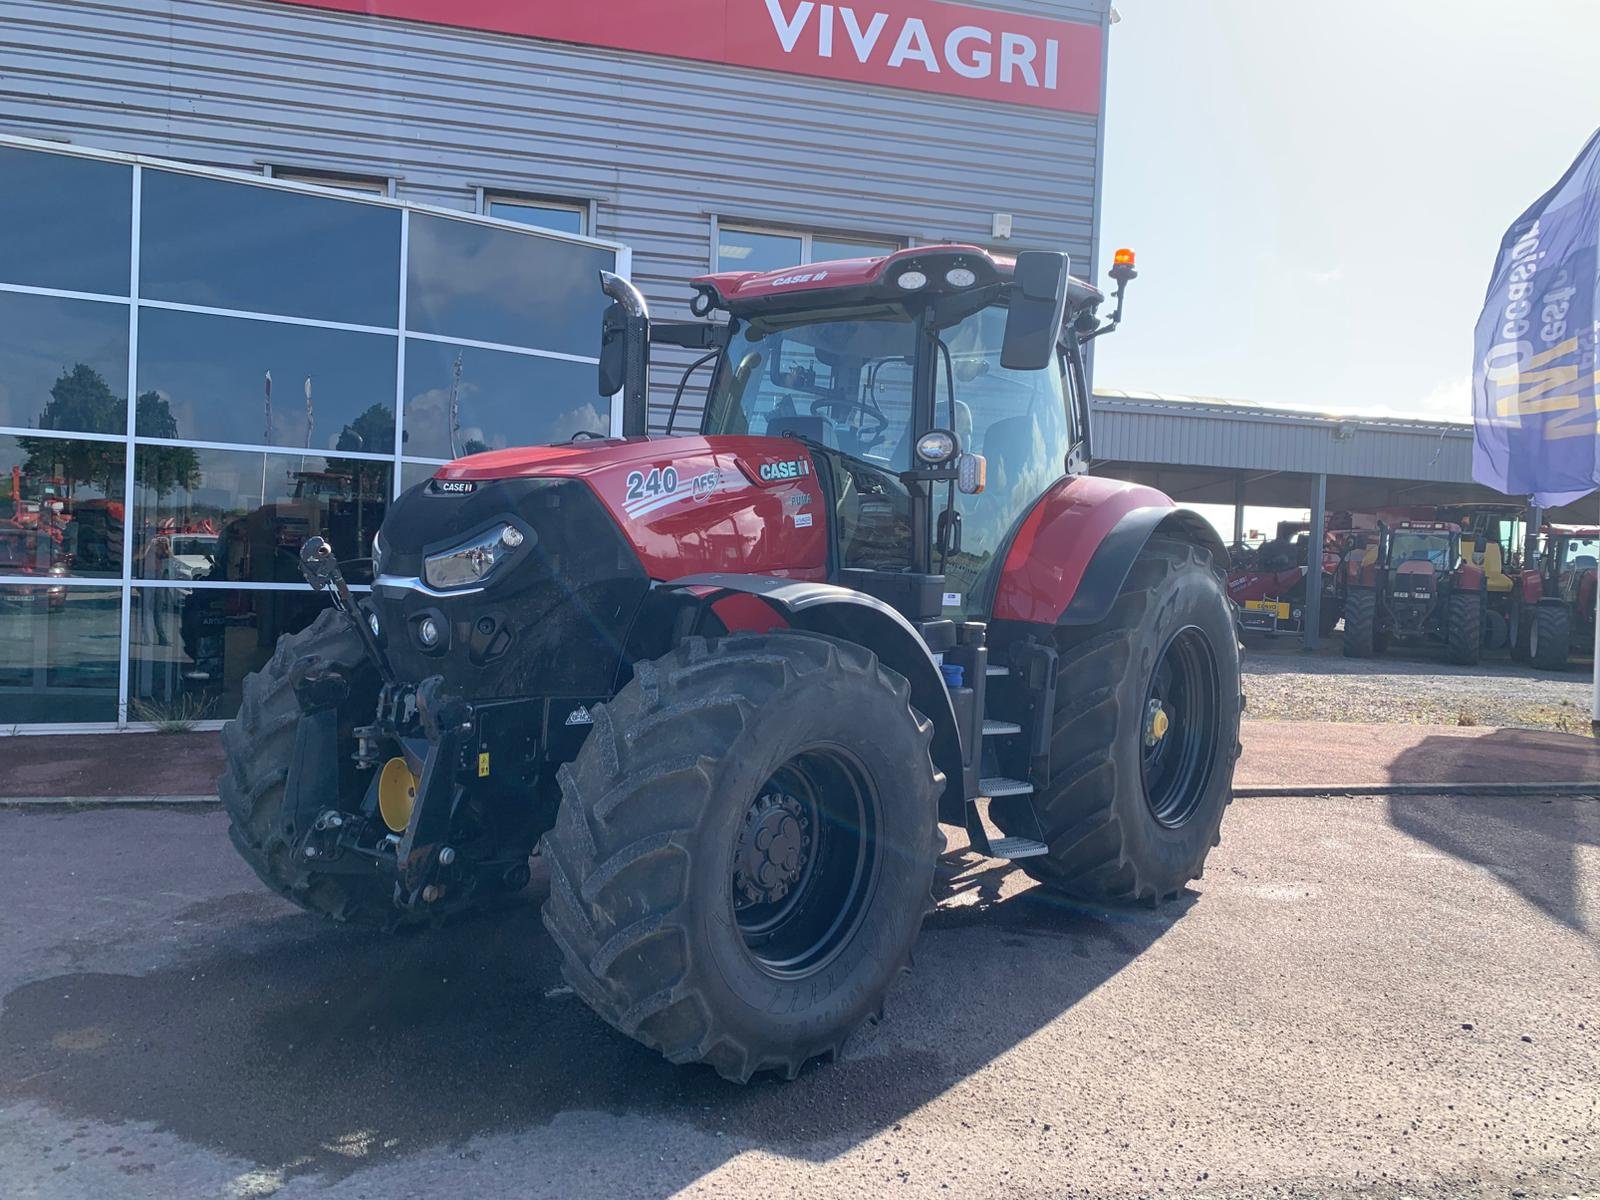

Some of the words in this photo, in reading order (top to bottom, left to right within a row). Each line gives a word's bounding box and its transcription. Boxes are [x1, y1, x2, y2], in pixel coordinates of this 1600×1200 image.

[765, 0, 1059, 89] VIVAGRI
[772, 274, 813, 286] CASE
[760, 461, 797, 480] CASE
[443, 482, 465, 492] CASE
[627, 467, 679, 501] 240
[691, 473, 716, 495] AFS
